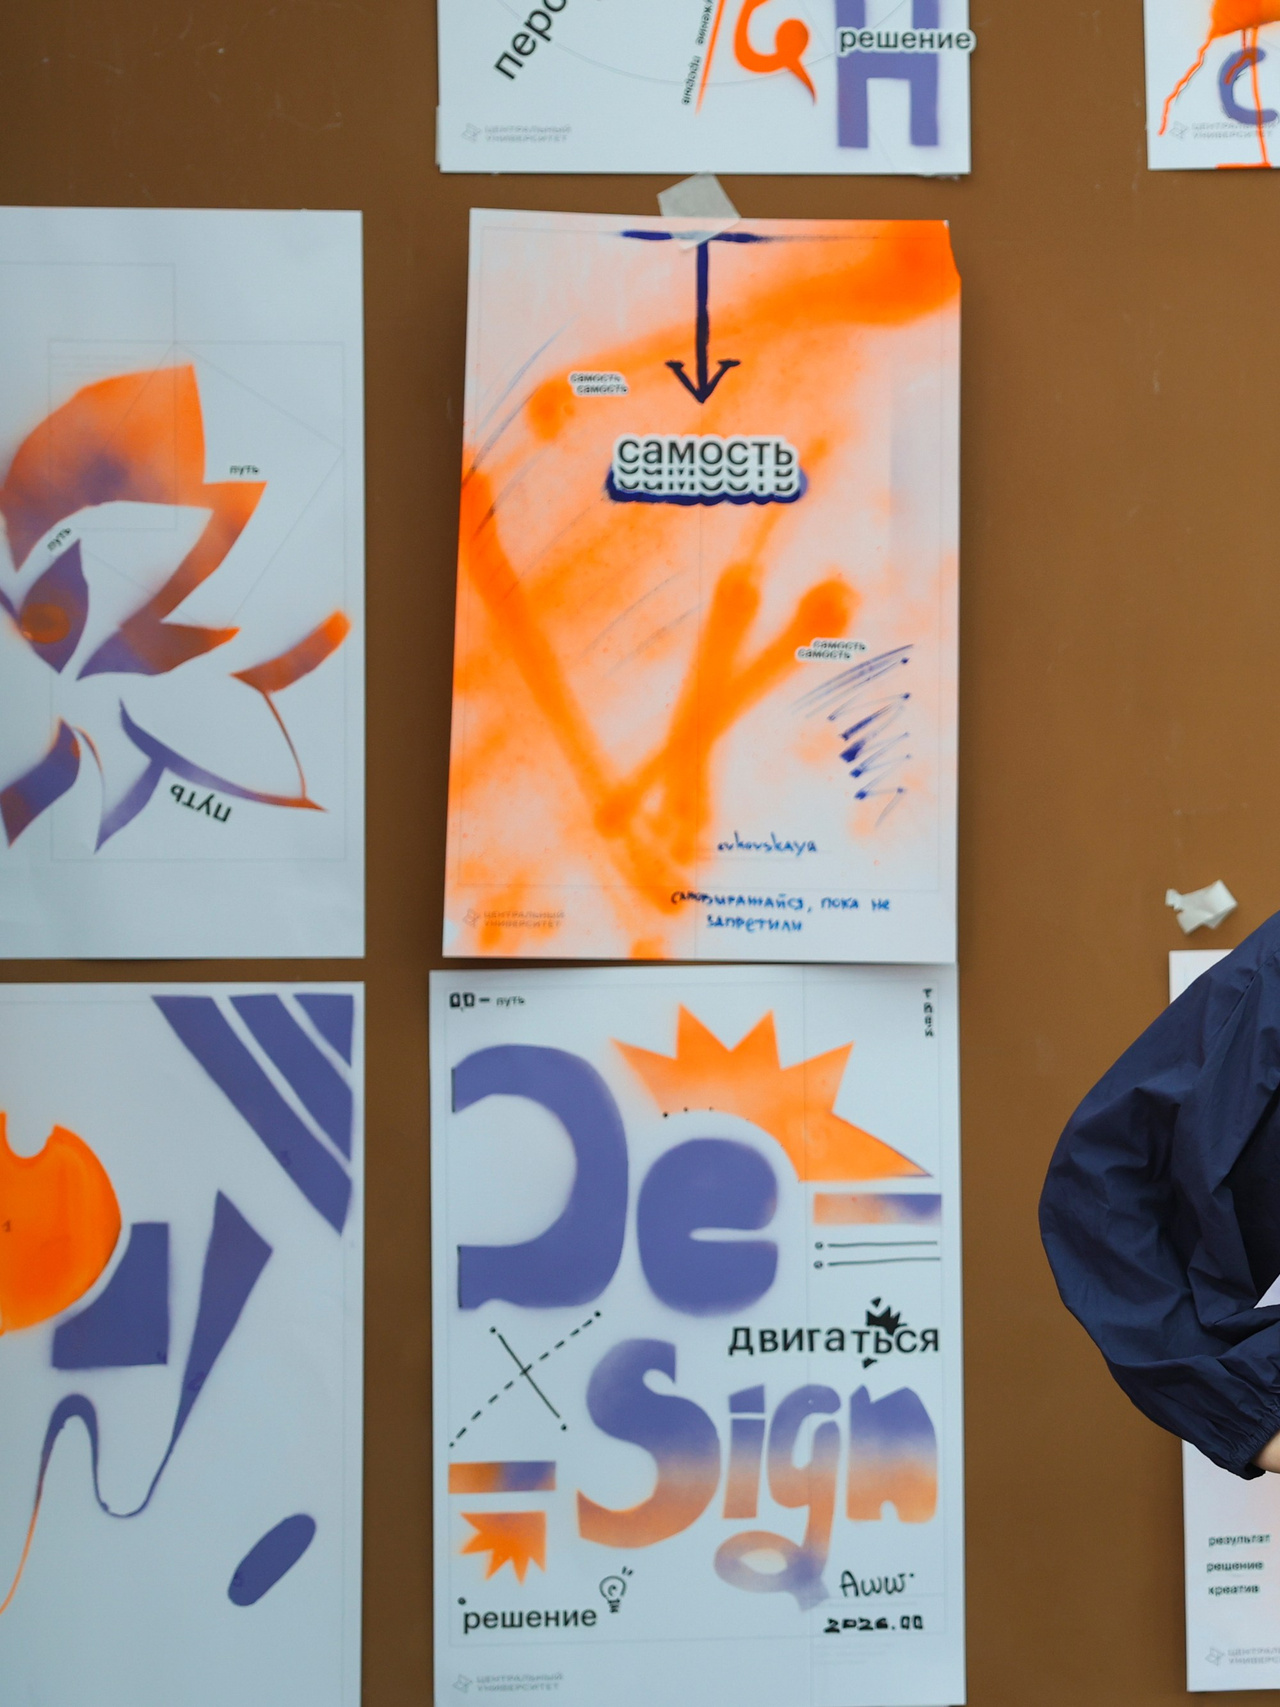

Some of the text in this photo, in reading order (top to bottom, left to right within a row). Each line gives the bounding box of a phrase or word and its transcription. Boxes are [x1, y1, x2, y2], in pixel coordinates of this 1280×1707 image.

[696, 0, 713, 45] жение
[840, 31, 971, 52] решение
[618, 440, 793, 466] самость
[229, 465, 260, 476] путь
[47, 527, 71, 551] путь
[170, 784, 232, 822] путь
[728, 1326, 940, 1356] двигаться
[576, 1337, 939, 1611] Sign
[1208, 1535, 1270, 1547] результат
[1206, 1562, 1264, 1572] решение
[1208, 1585, 1260, 1596] креатив
[463, 1609, 598, 1635] решение
